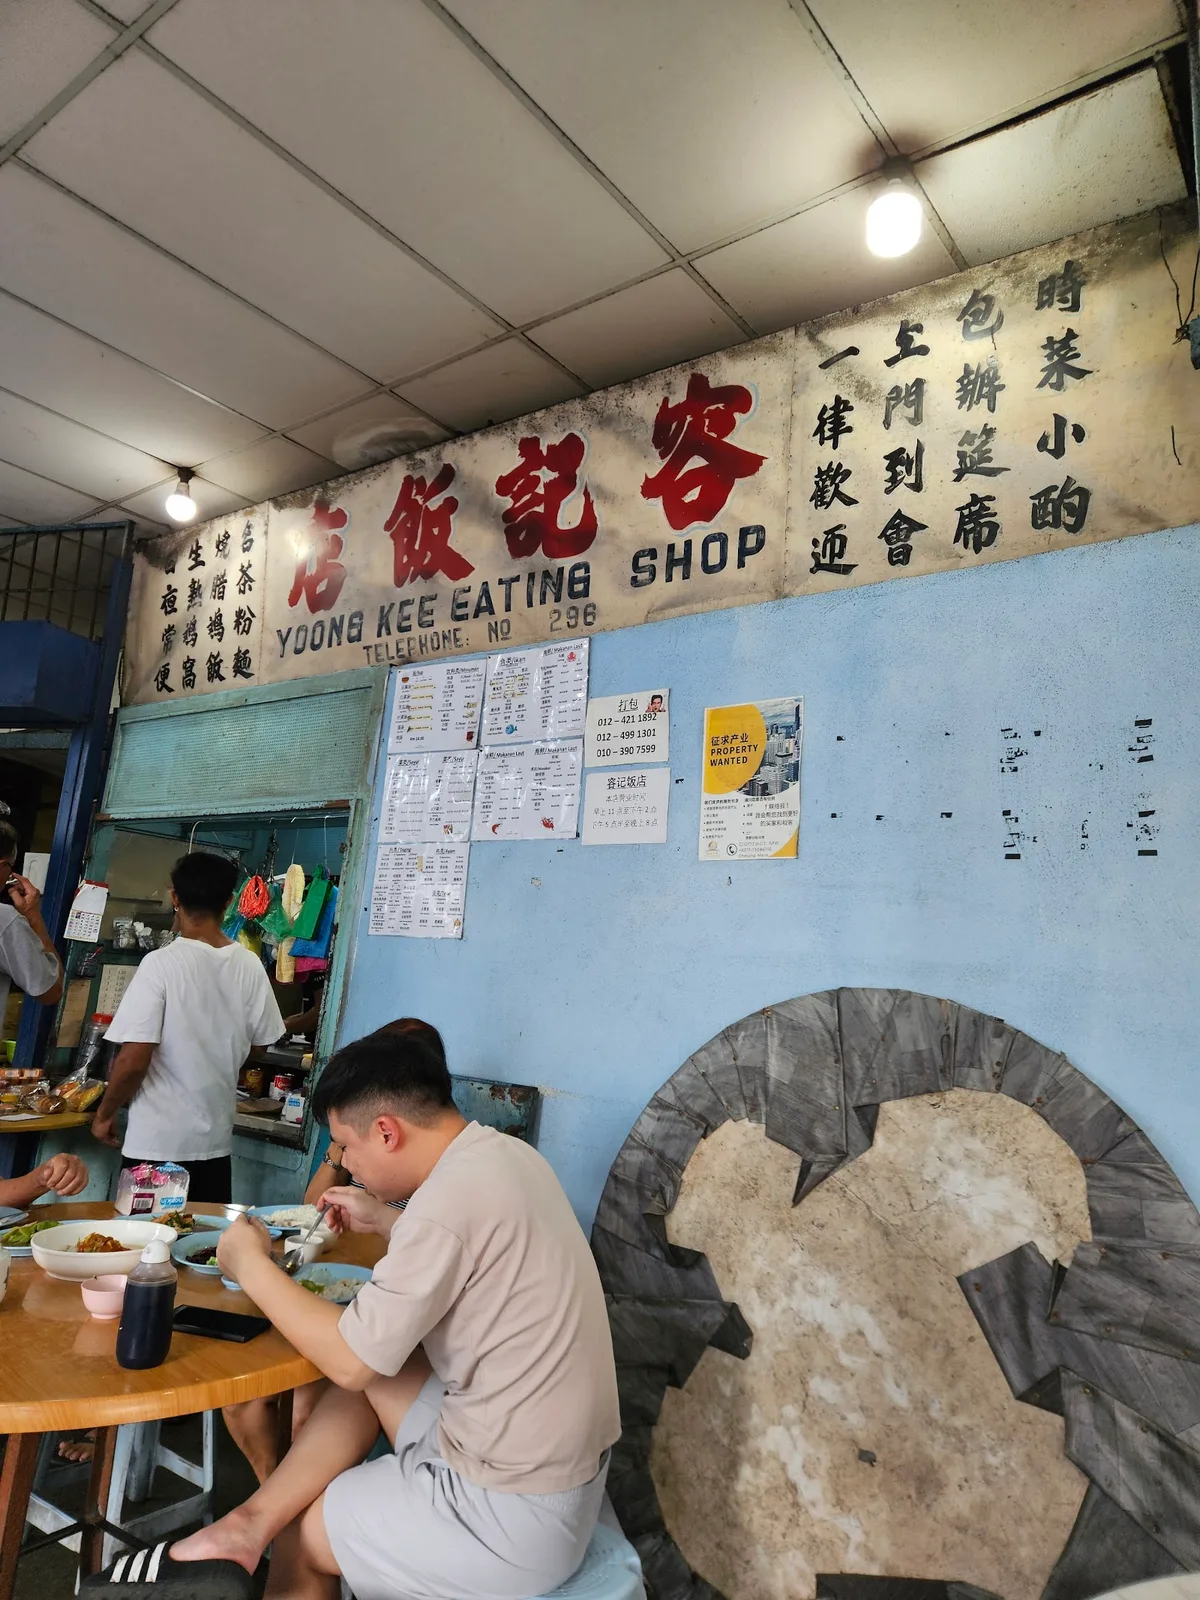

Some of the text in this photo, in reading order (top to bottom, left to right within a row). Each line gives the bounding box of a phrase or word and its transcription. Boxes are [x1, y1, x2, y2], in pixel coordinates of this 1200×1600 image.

[1029, 260, 1093, 534] 時菜小酌
[952, 288, 1011, 555] 包辦筵席
[877, 319, 930, 567] 上門到會
[276, 524, 767, 658] YOONG KEE EATING SHOP
[363, 626, 469, 665] TELEPHONE:
[549, 602, 597, 633] 296
[618, 698, 638, 710] 打包
[597, 717, 613, 727] 012
[621, 714, 635, 724] 421
[638, 712, 657, 723] 1892
[596, 732, 611, 742] 012
[620, 731, 635, 740] 499
[637, 728, 656, 738] 1301
[711, 732, 749, 746] 征求产业
[596, 749, 611, 758] 010
[620, 746, 634, 755] 390
[636, 744, 656, 754] 7599
[710, 744, 759, 756] PROPERTY
[710, 756, 748, 767] WANTED
[606, 775, 647, 790] 容记饭店
